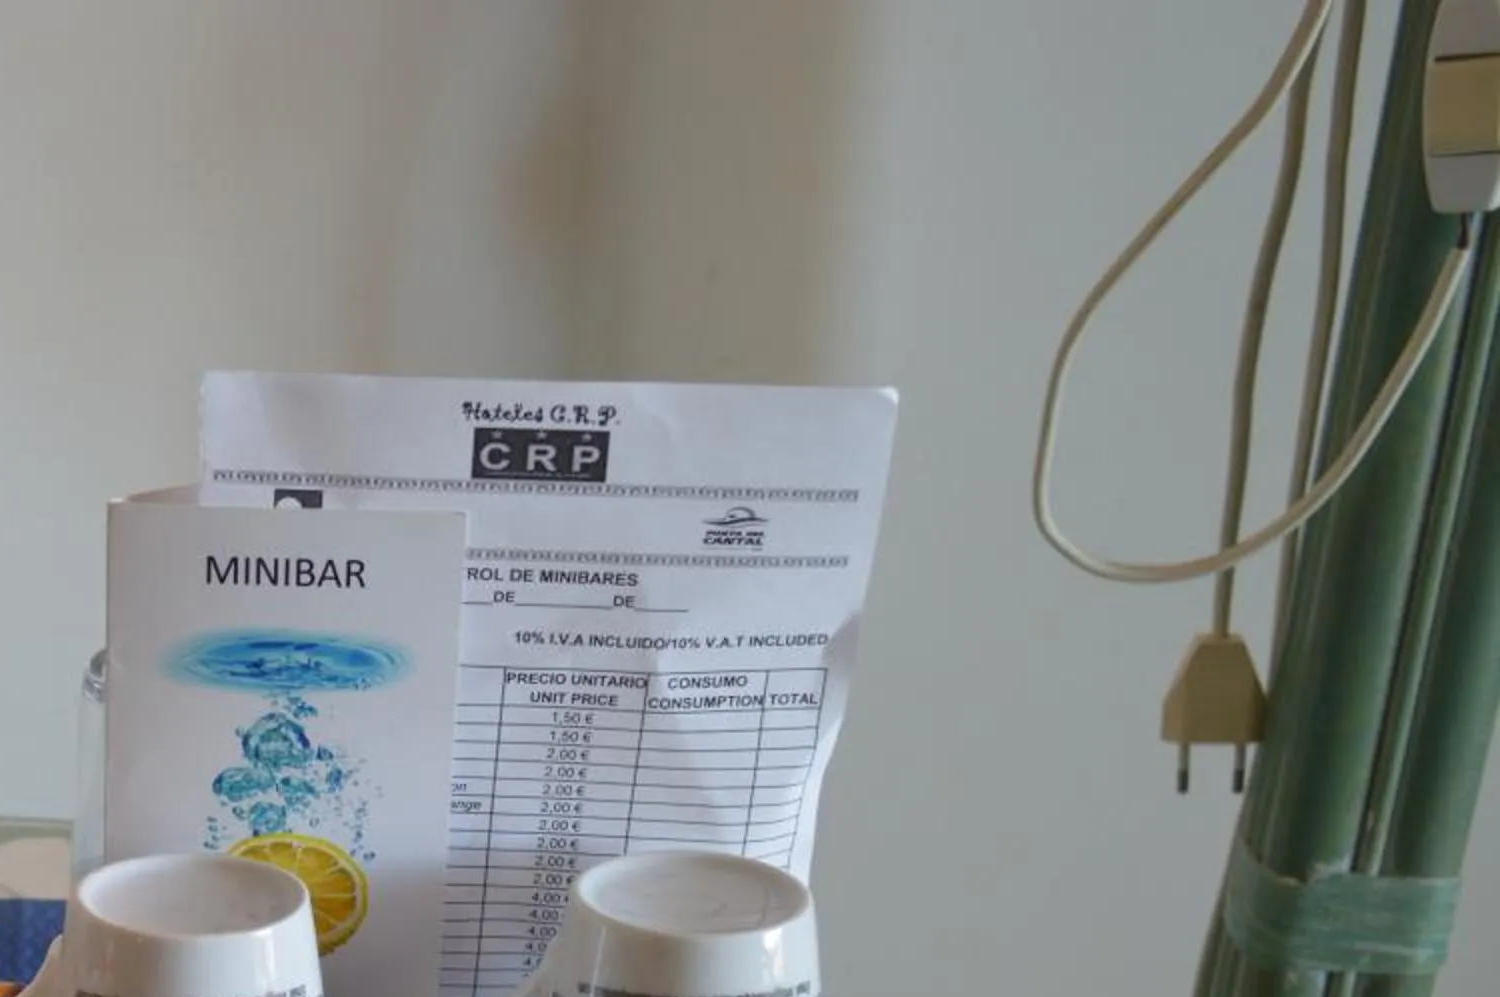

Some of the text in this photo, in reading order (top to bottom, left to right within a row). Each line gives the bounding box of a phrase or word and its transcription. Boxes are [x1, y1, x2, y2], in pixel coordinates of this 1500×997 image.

[206, 555, 366, 588] MINIBAR
[467, 567, 639, 587] ROL DE MINIBARES
[492, 590, 637, 608] DE DE
[515, 631, 545, 645] 10%
[749, 633, 829, 647] INCLUDED
[506, 672, 647, 690] PRECIO UNITARIO
[667, 675, 749, 690] CONSUMO
[530, 691, 620, 707] UNIT PRICE
[648, 694, 764, 710] CONSUMPTION
[769, 693, 819, 706] TOTAL
